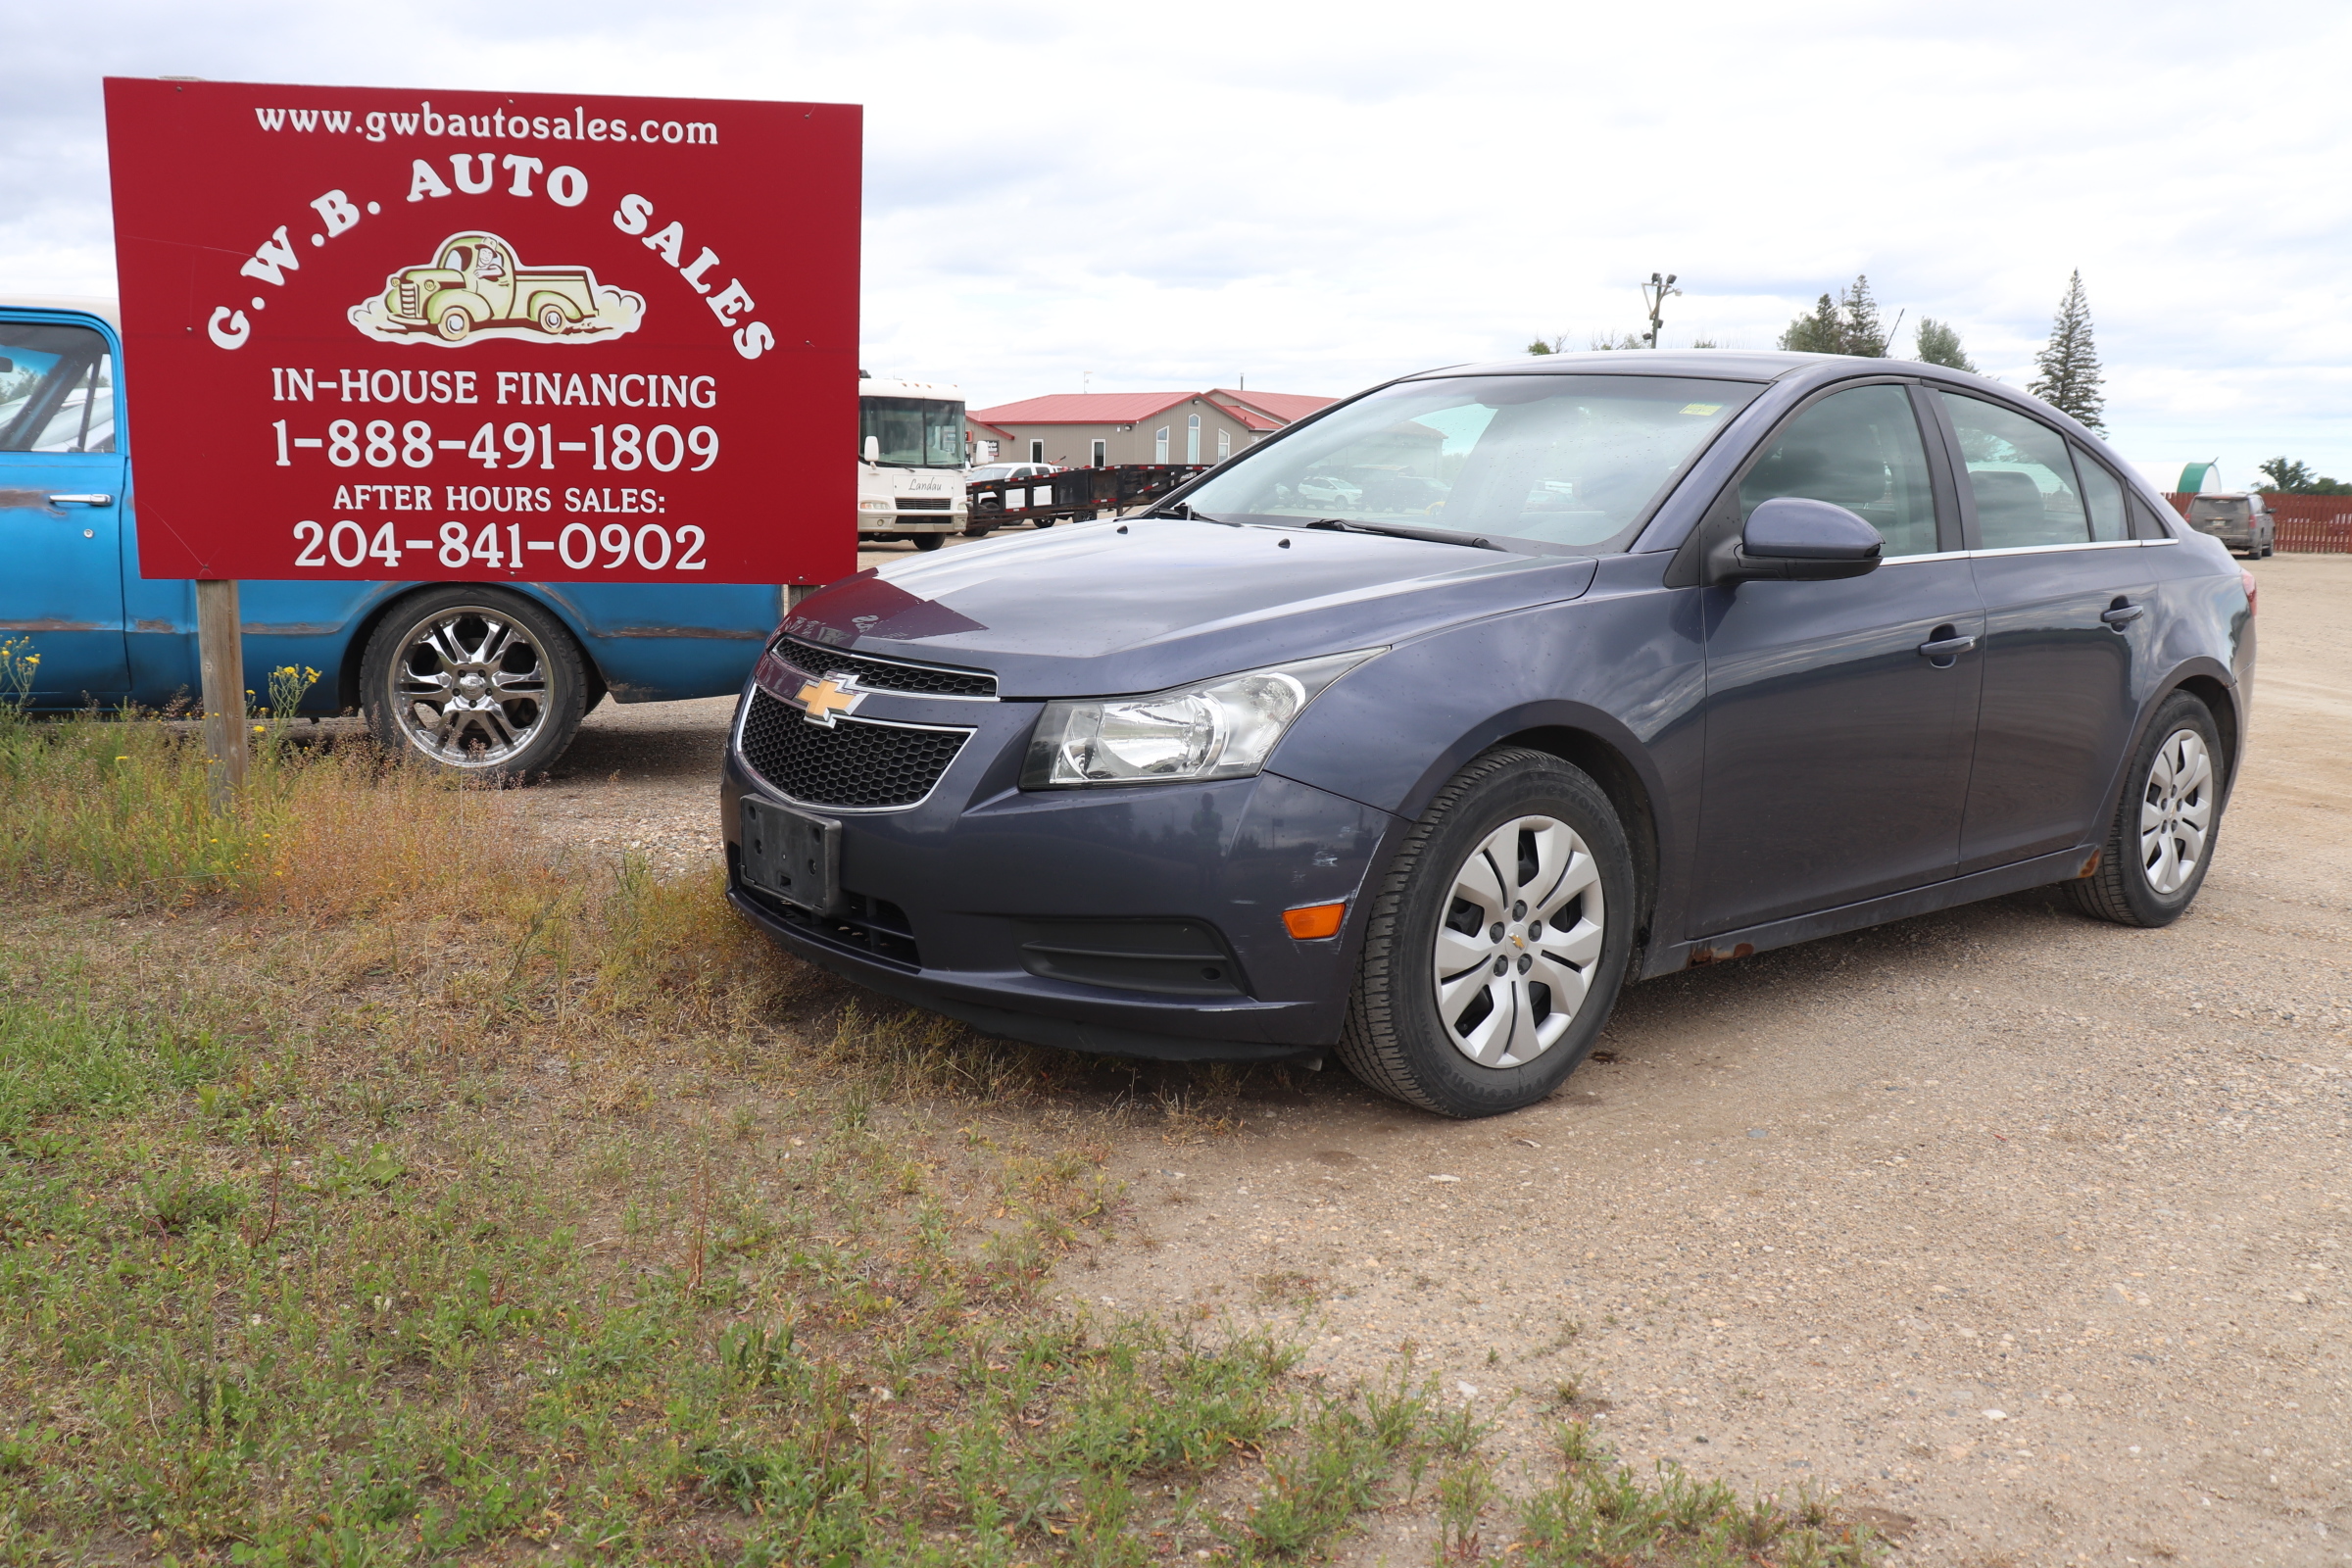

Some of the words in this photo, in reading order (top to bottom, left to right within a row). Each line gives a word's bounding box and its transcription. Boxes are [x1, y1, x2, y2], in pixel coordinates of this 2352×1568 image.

[255, 101, 718, 145] www.gwbautosales.com
[208, 189, 380, 350] G.W.B.
[407, 153, 588, 207] AUTO
[613, 194, 774, 359] SALES
[271, 368, 477, 405] IN-HOUSE
[497, 372, 717, 409] FINANCING
[272, 419, 719, 471] 1-888-491-1809
[333, 485, 432, 511] AFTER
[446, 486, 551, 513] HOURS
[564, 488, 666, 514] SALES:
[907, 477, 943, 492] Landau
[294, 520, 707, 569] 204-841-0902
